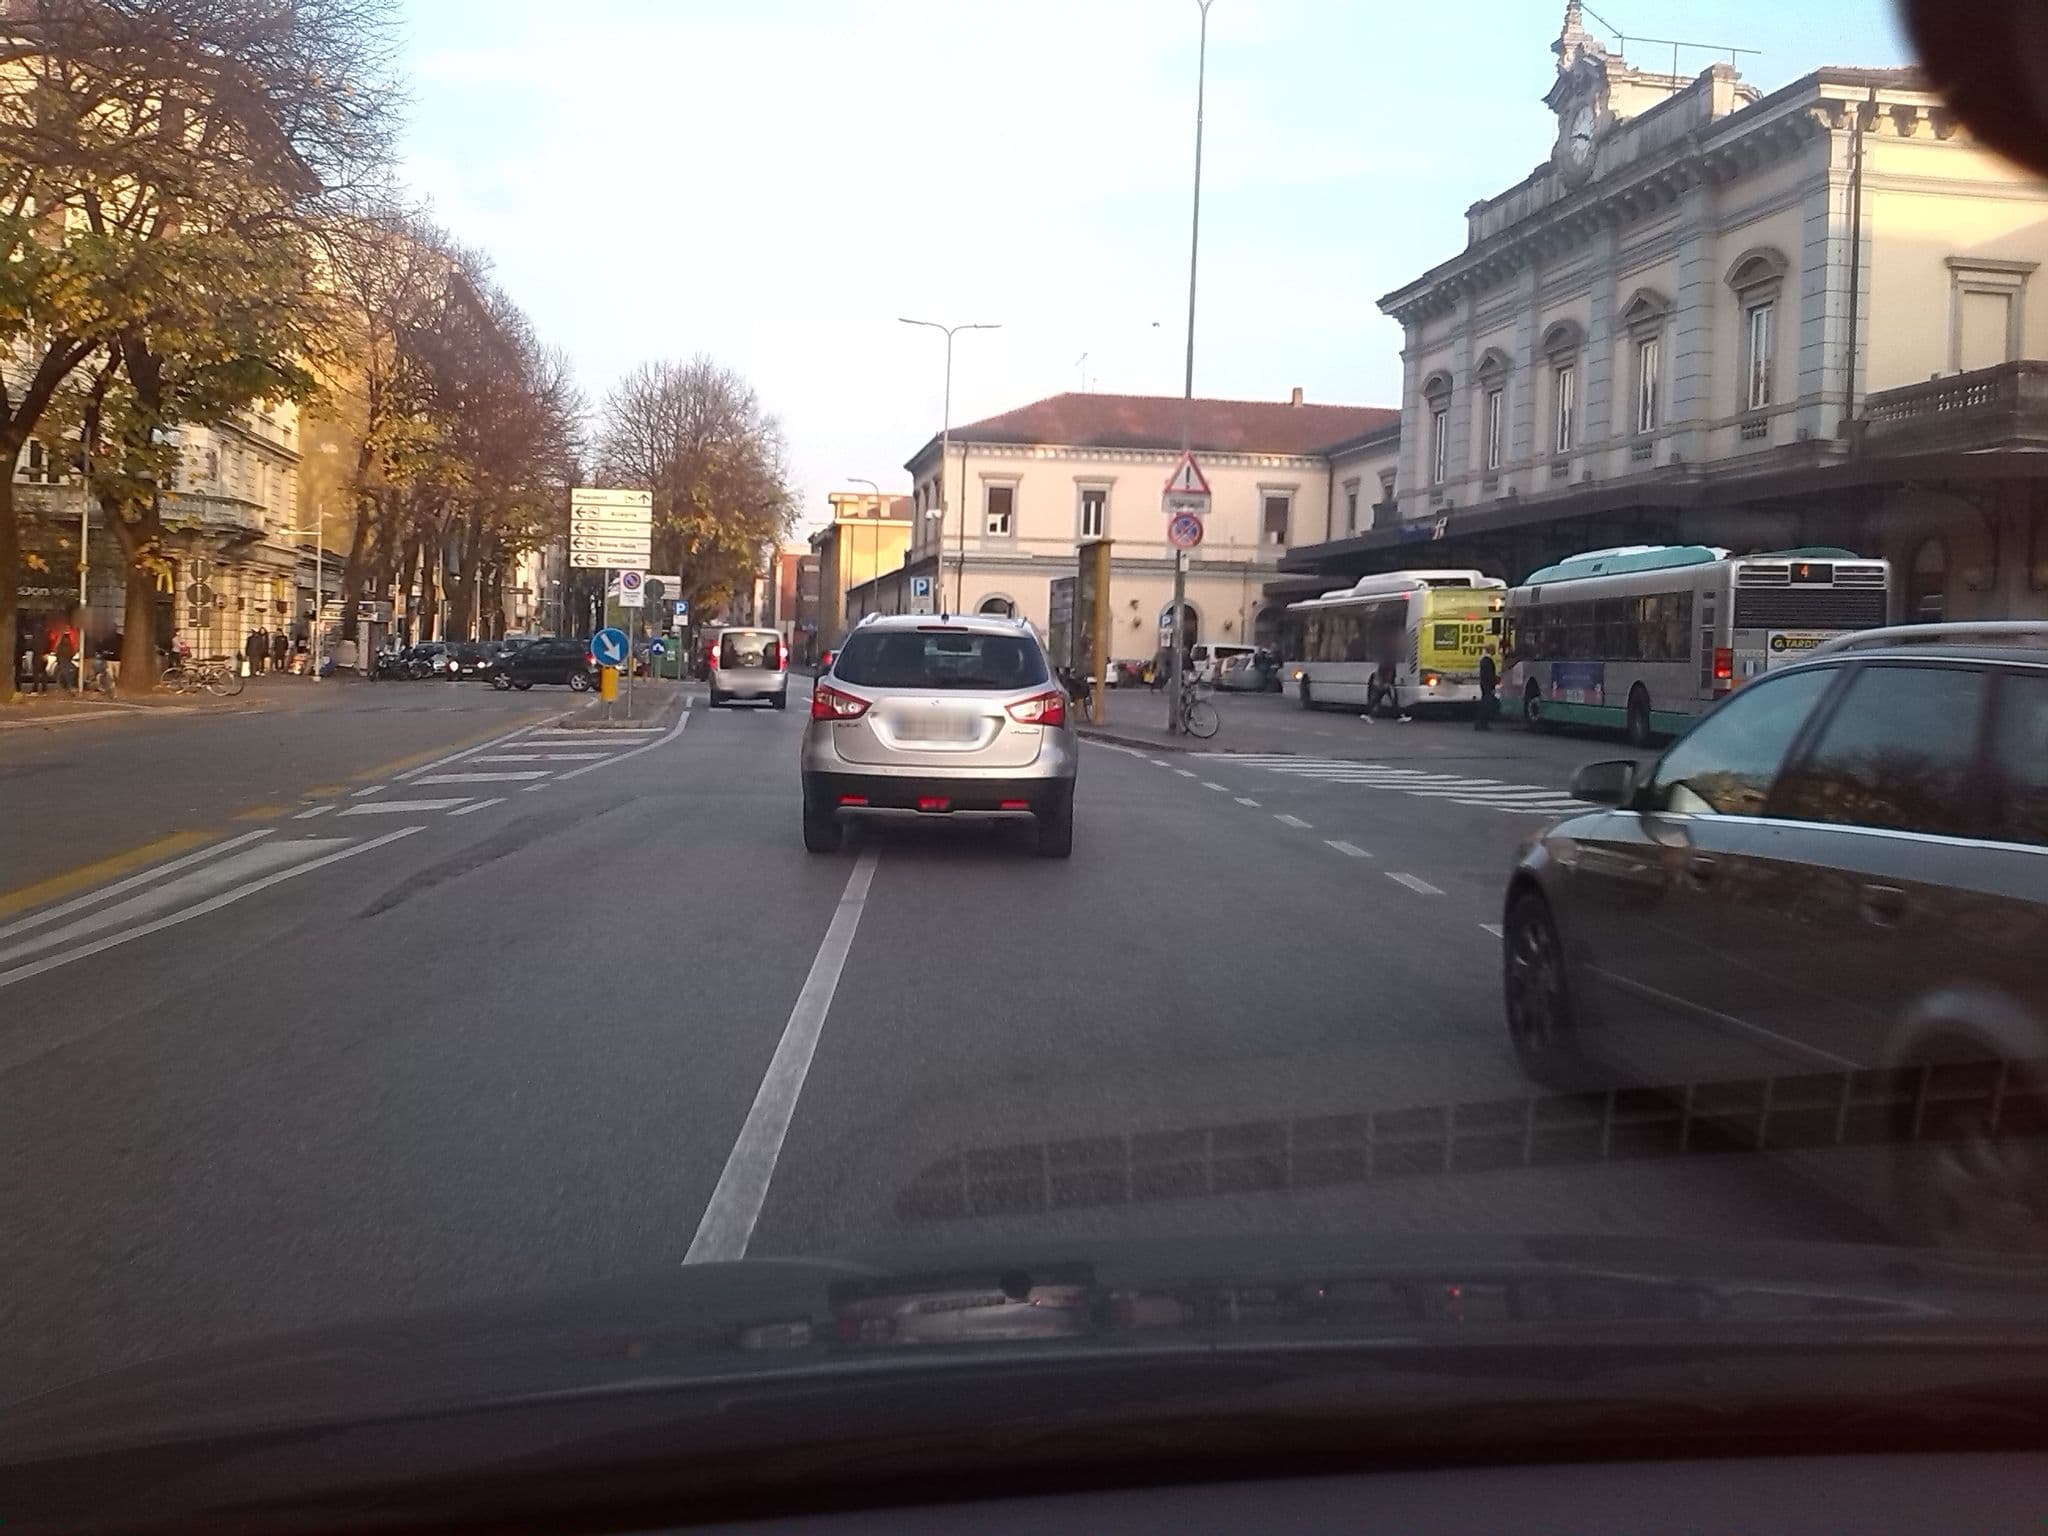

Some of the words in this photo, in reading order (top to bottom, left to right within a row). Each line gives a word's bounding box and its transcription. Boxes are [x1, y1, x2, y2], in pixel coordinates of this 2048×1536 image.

[915, 579, 927, 596] P
[676, 602, 686, 615] P
[1461, 624, 1484, 633] BIO
[1461, 635, 1485, 644] PER
